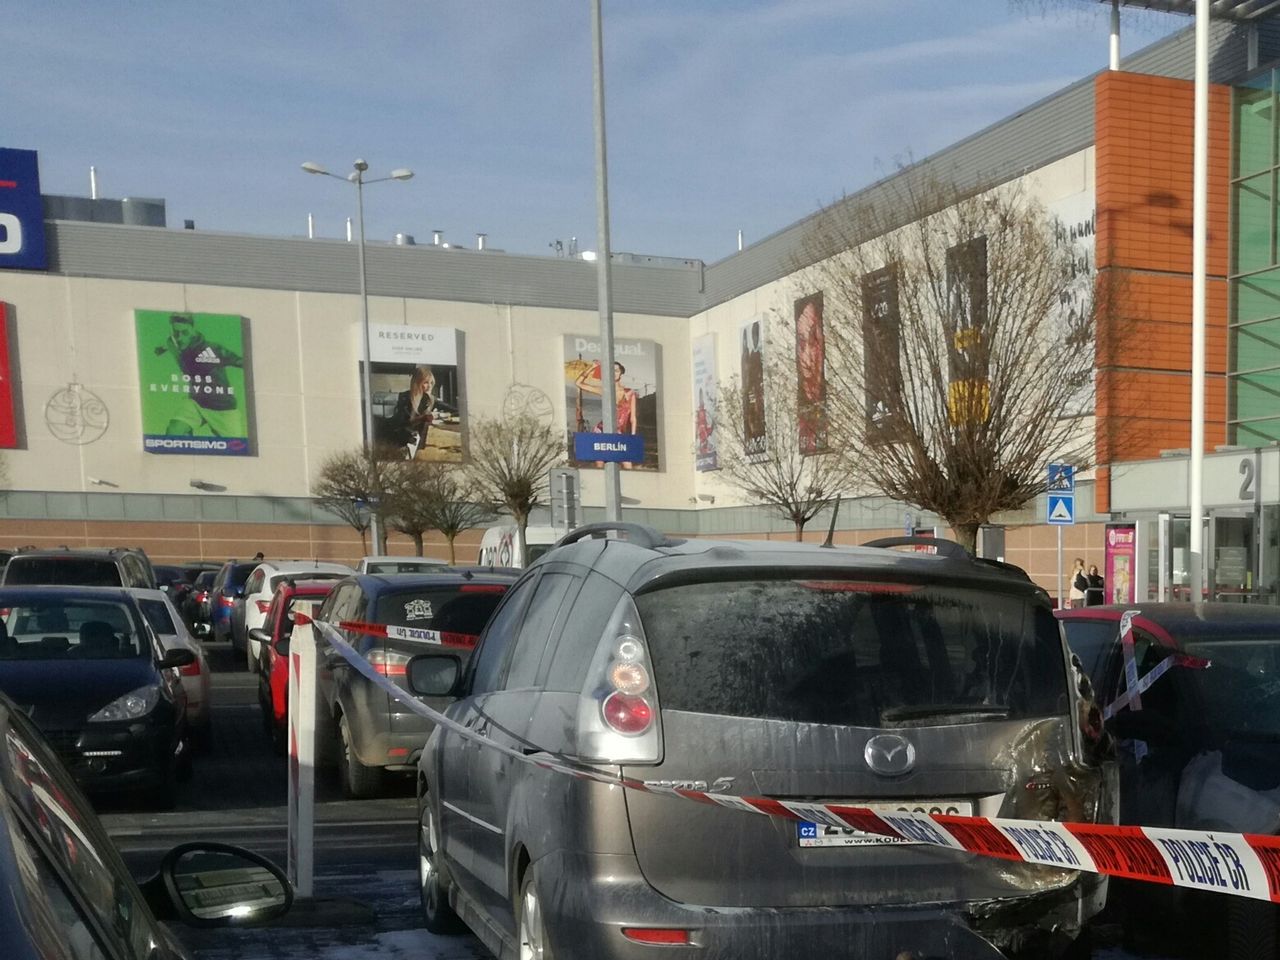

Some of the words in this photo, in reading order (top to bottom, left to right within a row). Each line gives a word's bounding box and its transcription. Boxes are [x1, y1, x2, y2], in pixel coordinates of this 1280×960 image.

[378, 331, 434, 341] RESERVED
[171, 374, 212, 383] BOSS
[150, 384, 234, 395] EVERYONE
[145, 439, 227, 450] SPORTISIMO
[593, 442, 627, 451] BERLÍN
[1239, 458, 1254, 500] 2
[801, 827, 815, 836] CZ
[1158, 838, 1227, 887] POLICIE
[1207, 834, 1250, 890] ČR
